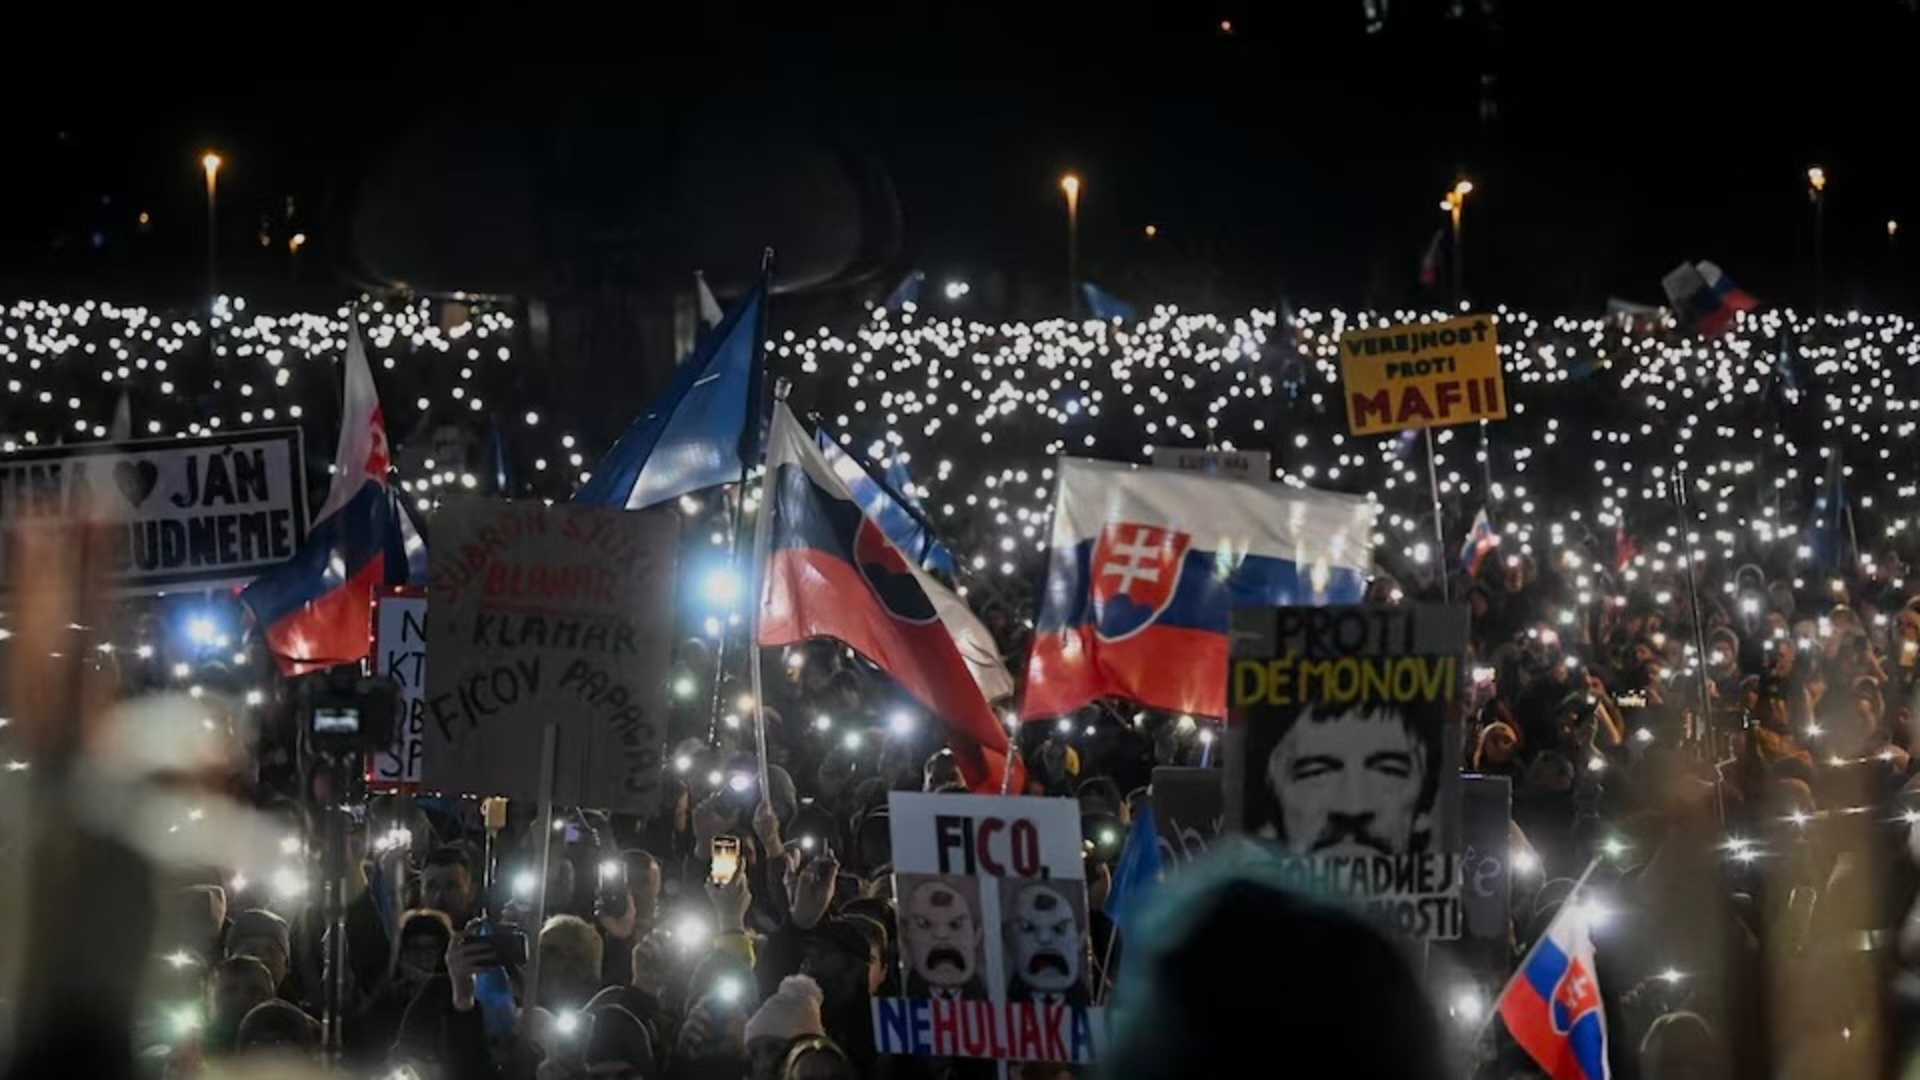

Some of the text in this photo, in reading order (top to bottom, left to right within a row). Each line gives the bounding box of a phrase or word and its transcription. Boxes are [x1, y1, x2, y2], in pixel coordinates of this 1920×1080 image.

[1385, 356, 1456, 380] PROTI
[1351, 377, 1499, 427] MAFII
[1276, 605, 1416, 655] PROTI
[428, 655, 541, 743] FICOV
[1233, 644, 1456, 706] DÉMONOVI
[935, 815, 1049, 880] FICO,
